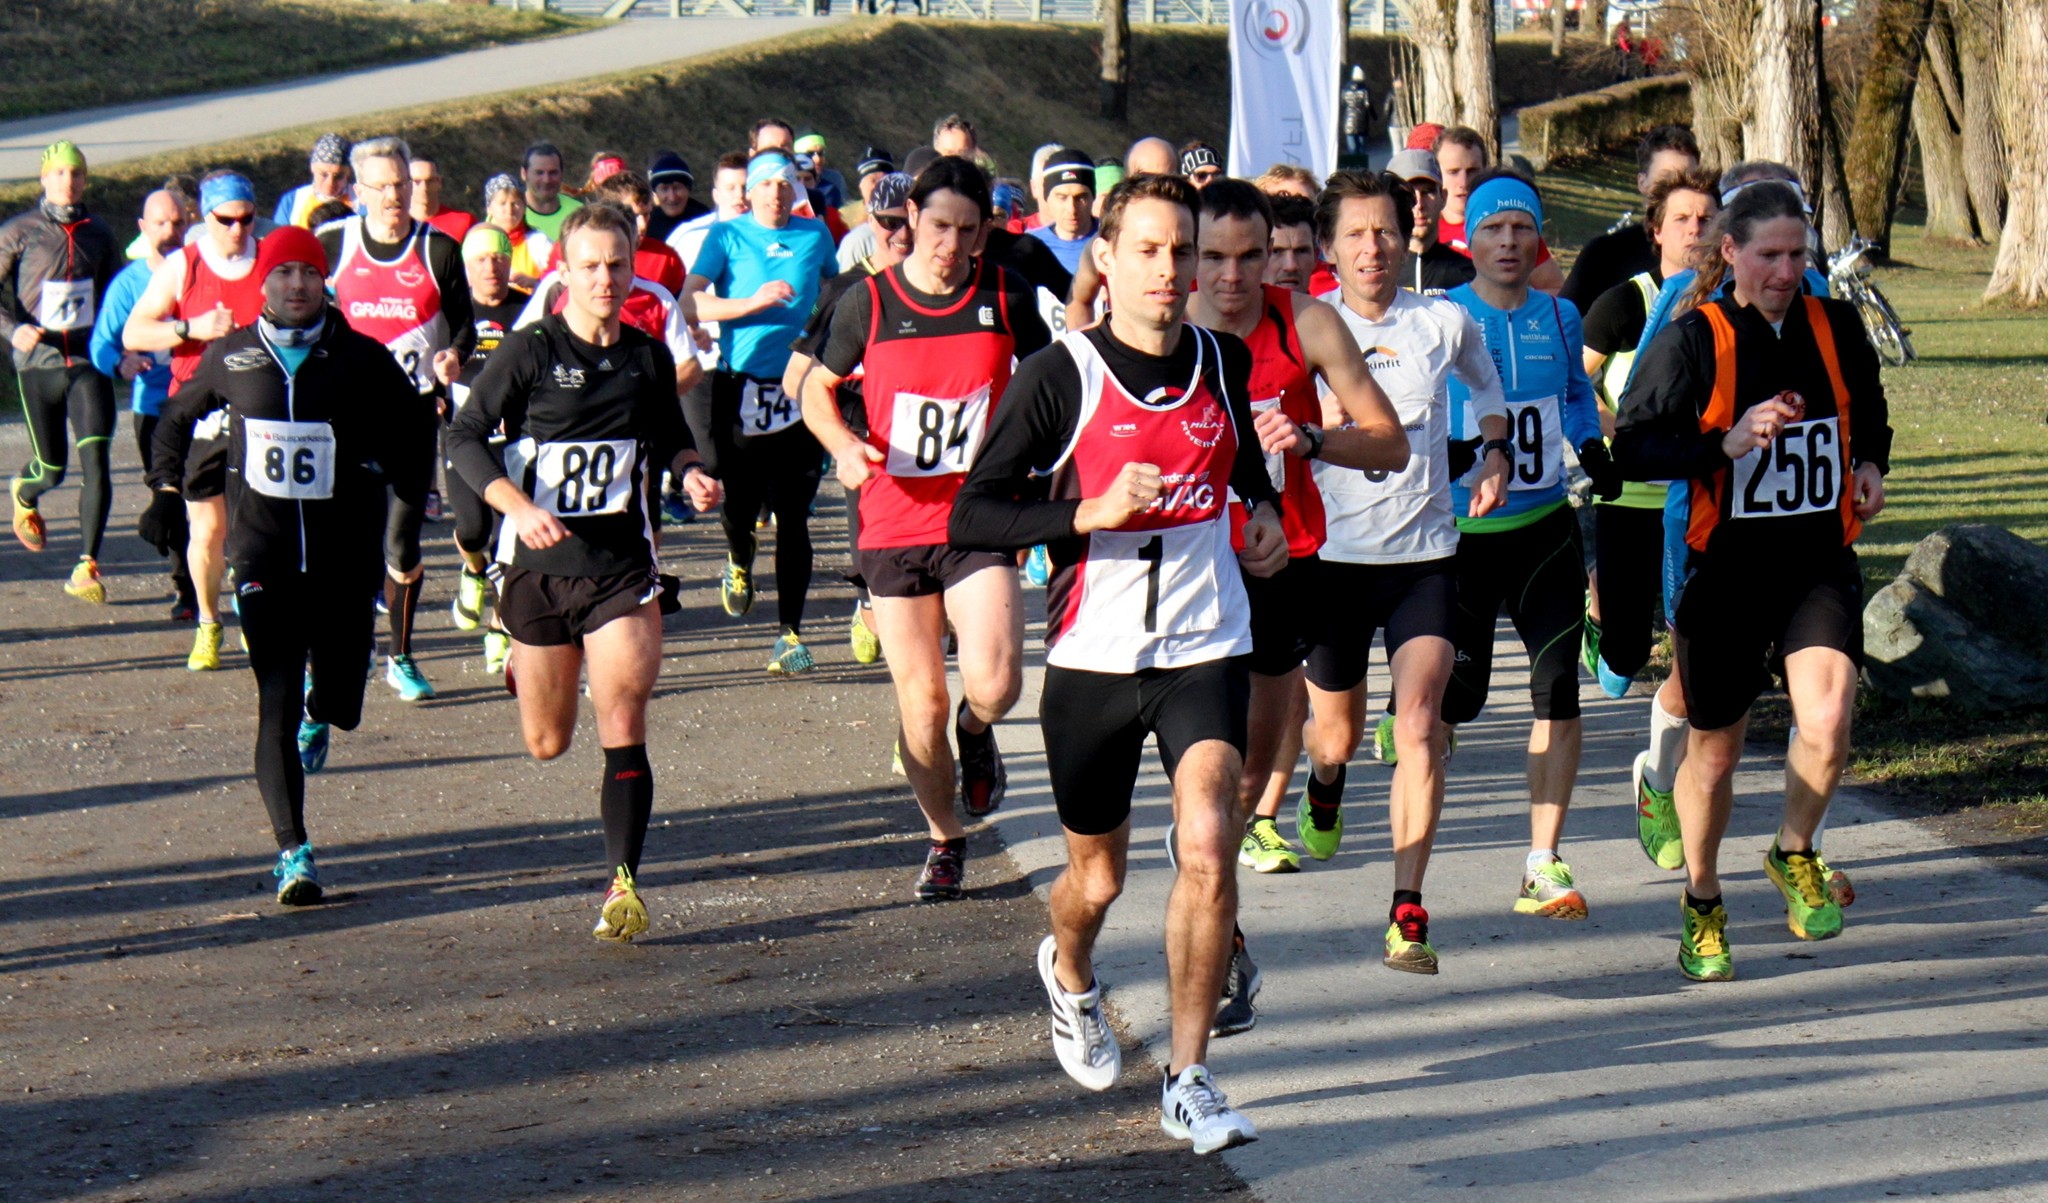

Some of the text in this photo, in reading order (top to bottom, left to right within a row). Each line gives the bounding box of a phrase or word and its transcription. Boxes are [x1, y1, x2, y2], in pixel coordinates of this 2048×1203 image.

[350, 302, 417, 320] GRAVAG
[755, 386, 793, 431] 54
[916, 400, 969, 471] 84
[264, 446, 316, 485] 86
[556, 443, 616, 513] 89
[1743, 422, 1834, 513] 256
[1138, 534, 1163, 633] 1
